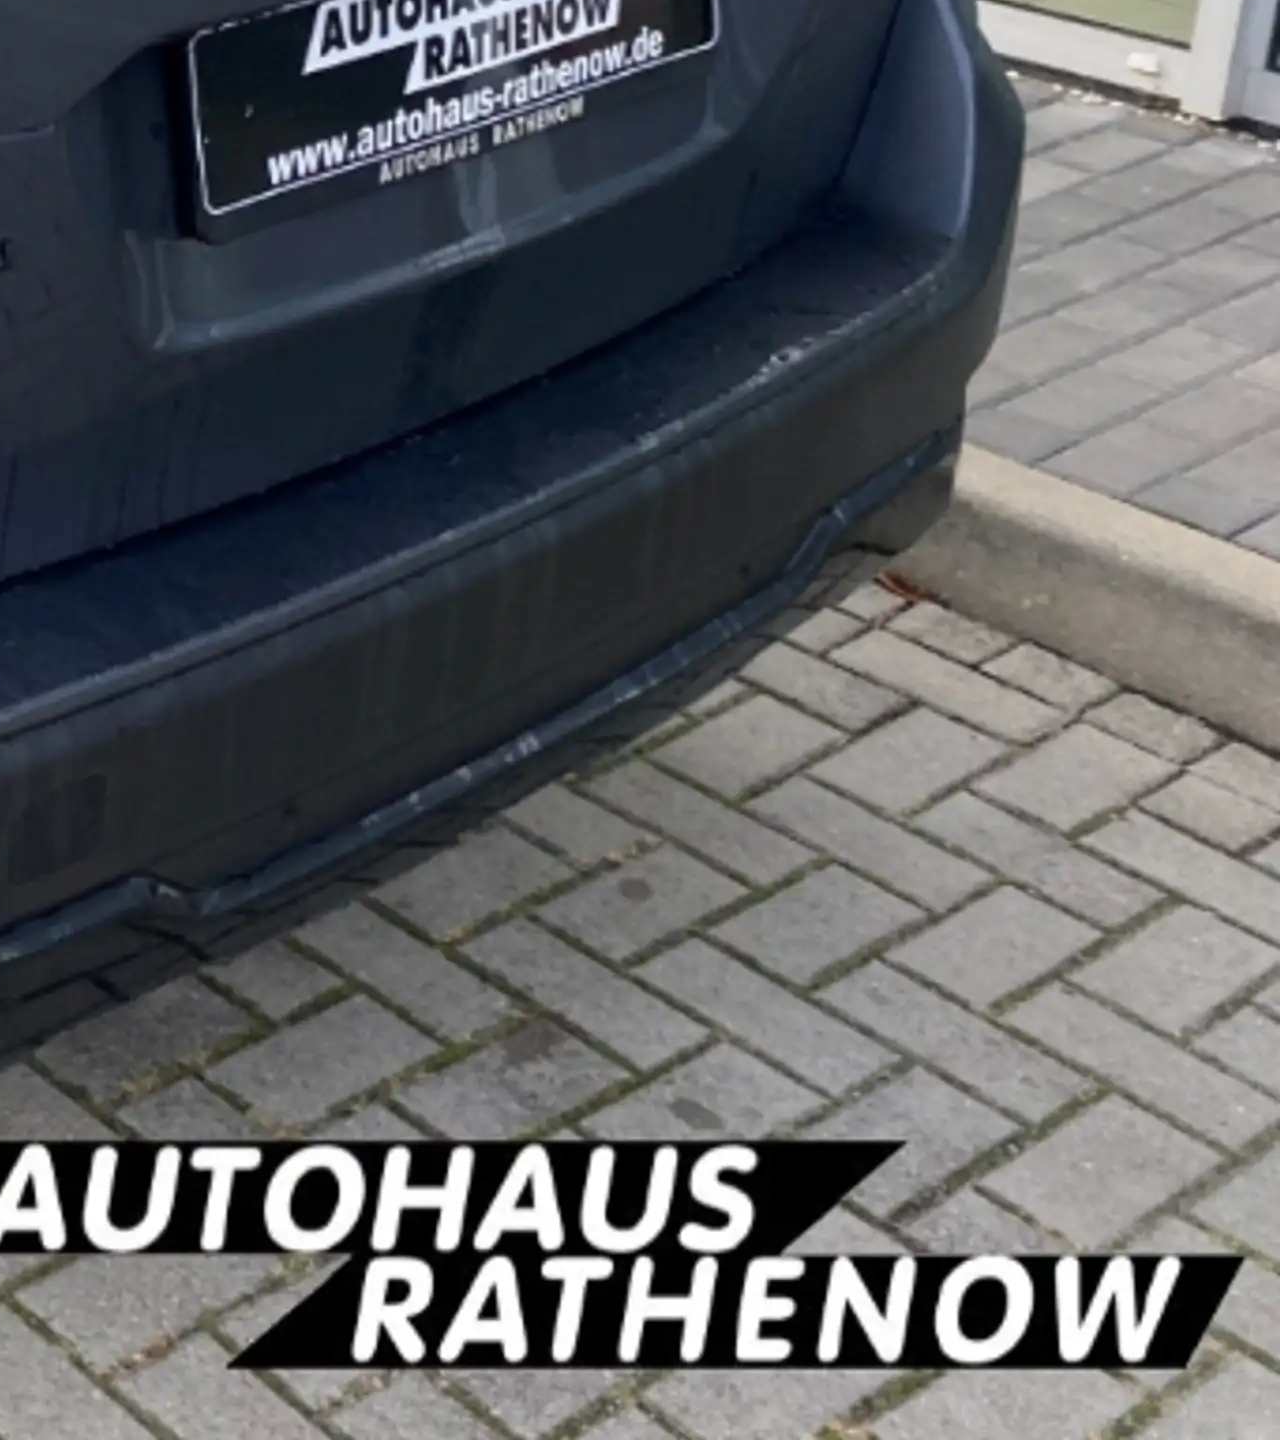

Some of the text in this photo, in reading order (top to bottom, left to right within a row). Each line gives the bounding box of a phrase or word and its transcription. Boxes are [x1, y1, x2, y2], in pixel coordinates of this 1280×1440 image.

[267, 25, 664, 185] www.autohaus-rathenow.de
[379, 95, 584, 185] AUTOHAUS RATHENOW
